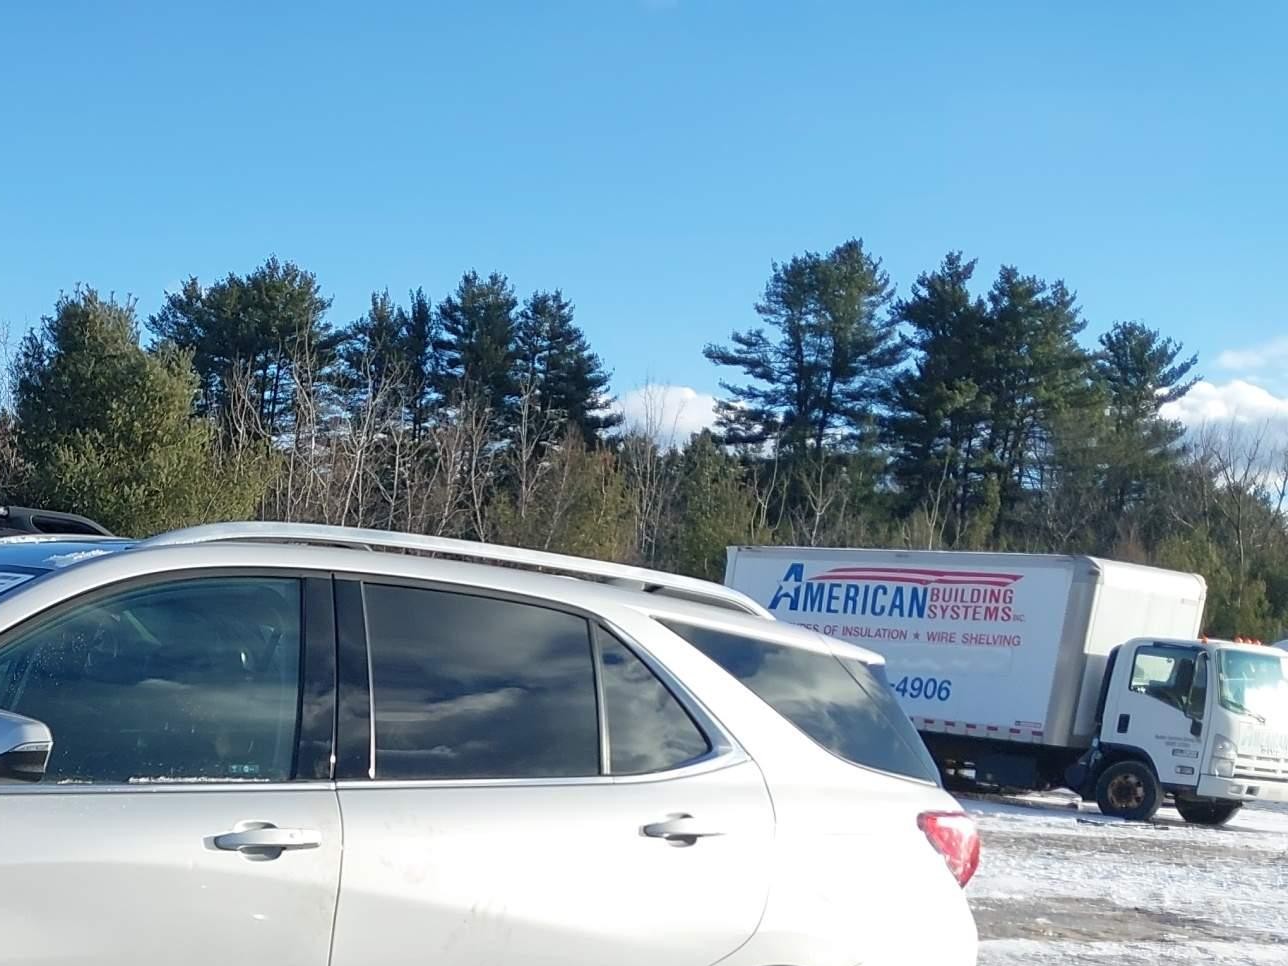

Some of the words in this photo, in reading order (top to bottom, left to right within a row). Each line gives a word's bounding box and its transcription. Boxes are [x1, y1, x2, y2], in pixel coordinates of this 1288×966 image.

[768, 563, 928, 618] AMERICAN
[929, 587, 1014, 605] BUILDING
[927, 604, 1012, 622] SYSTEMS
[823, 624, 838, 636] OF
[841, 626, 908, 641] INSULATION
[927, 631, 956, 644] WIRE
[961, 632, 1022, 647] SHELVING
